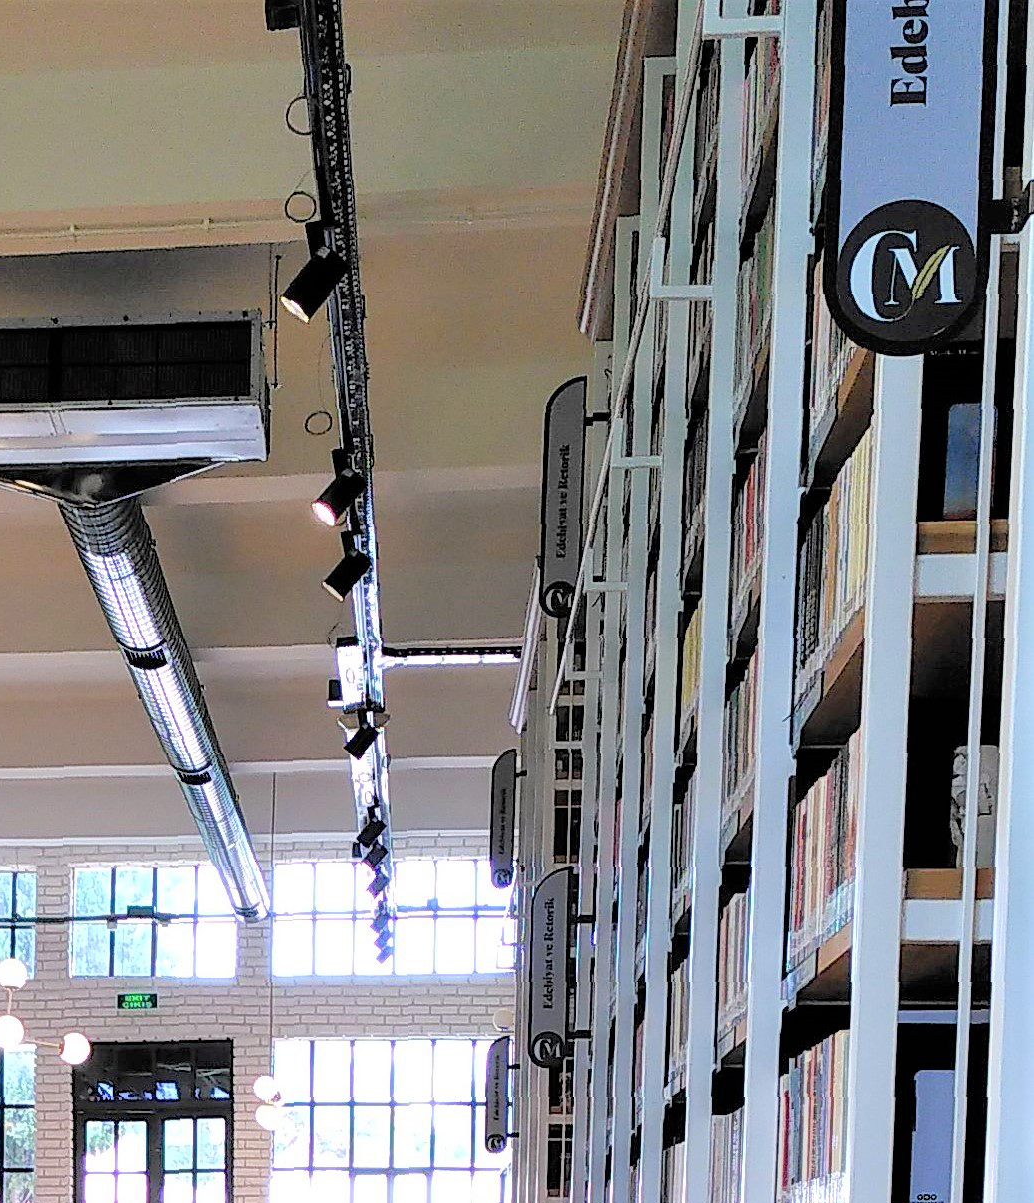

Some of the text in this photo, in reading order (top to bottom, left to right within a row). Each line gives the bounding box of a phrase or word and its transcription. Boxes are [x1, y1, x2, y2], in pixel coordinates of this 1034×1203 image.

[557, 444, 571, 489] Retorik
[544, 897, 555, 942] Retorik
[542, 959, 555, 1009] Edebiyat
